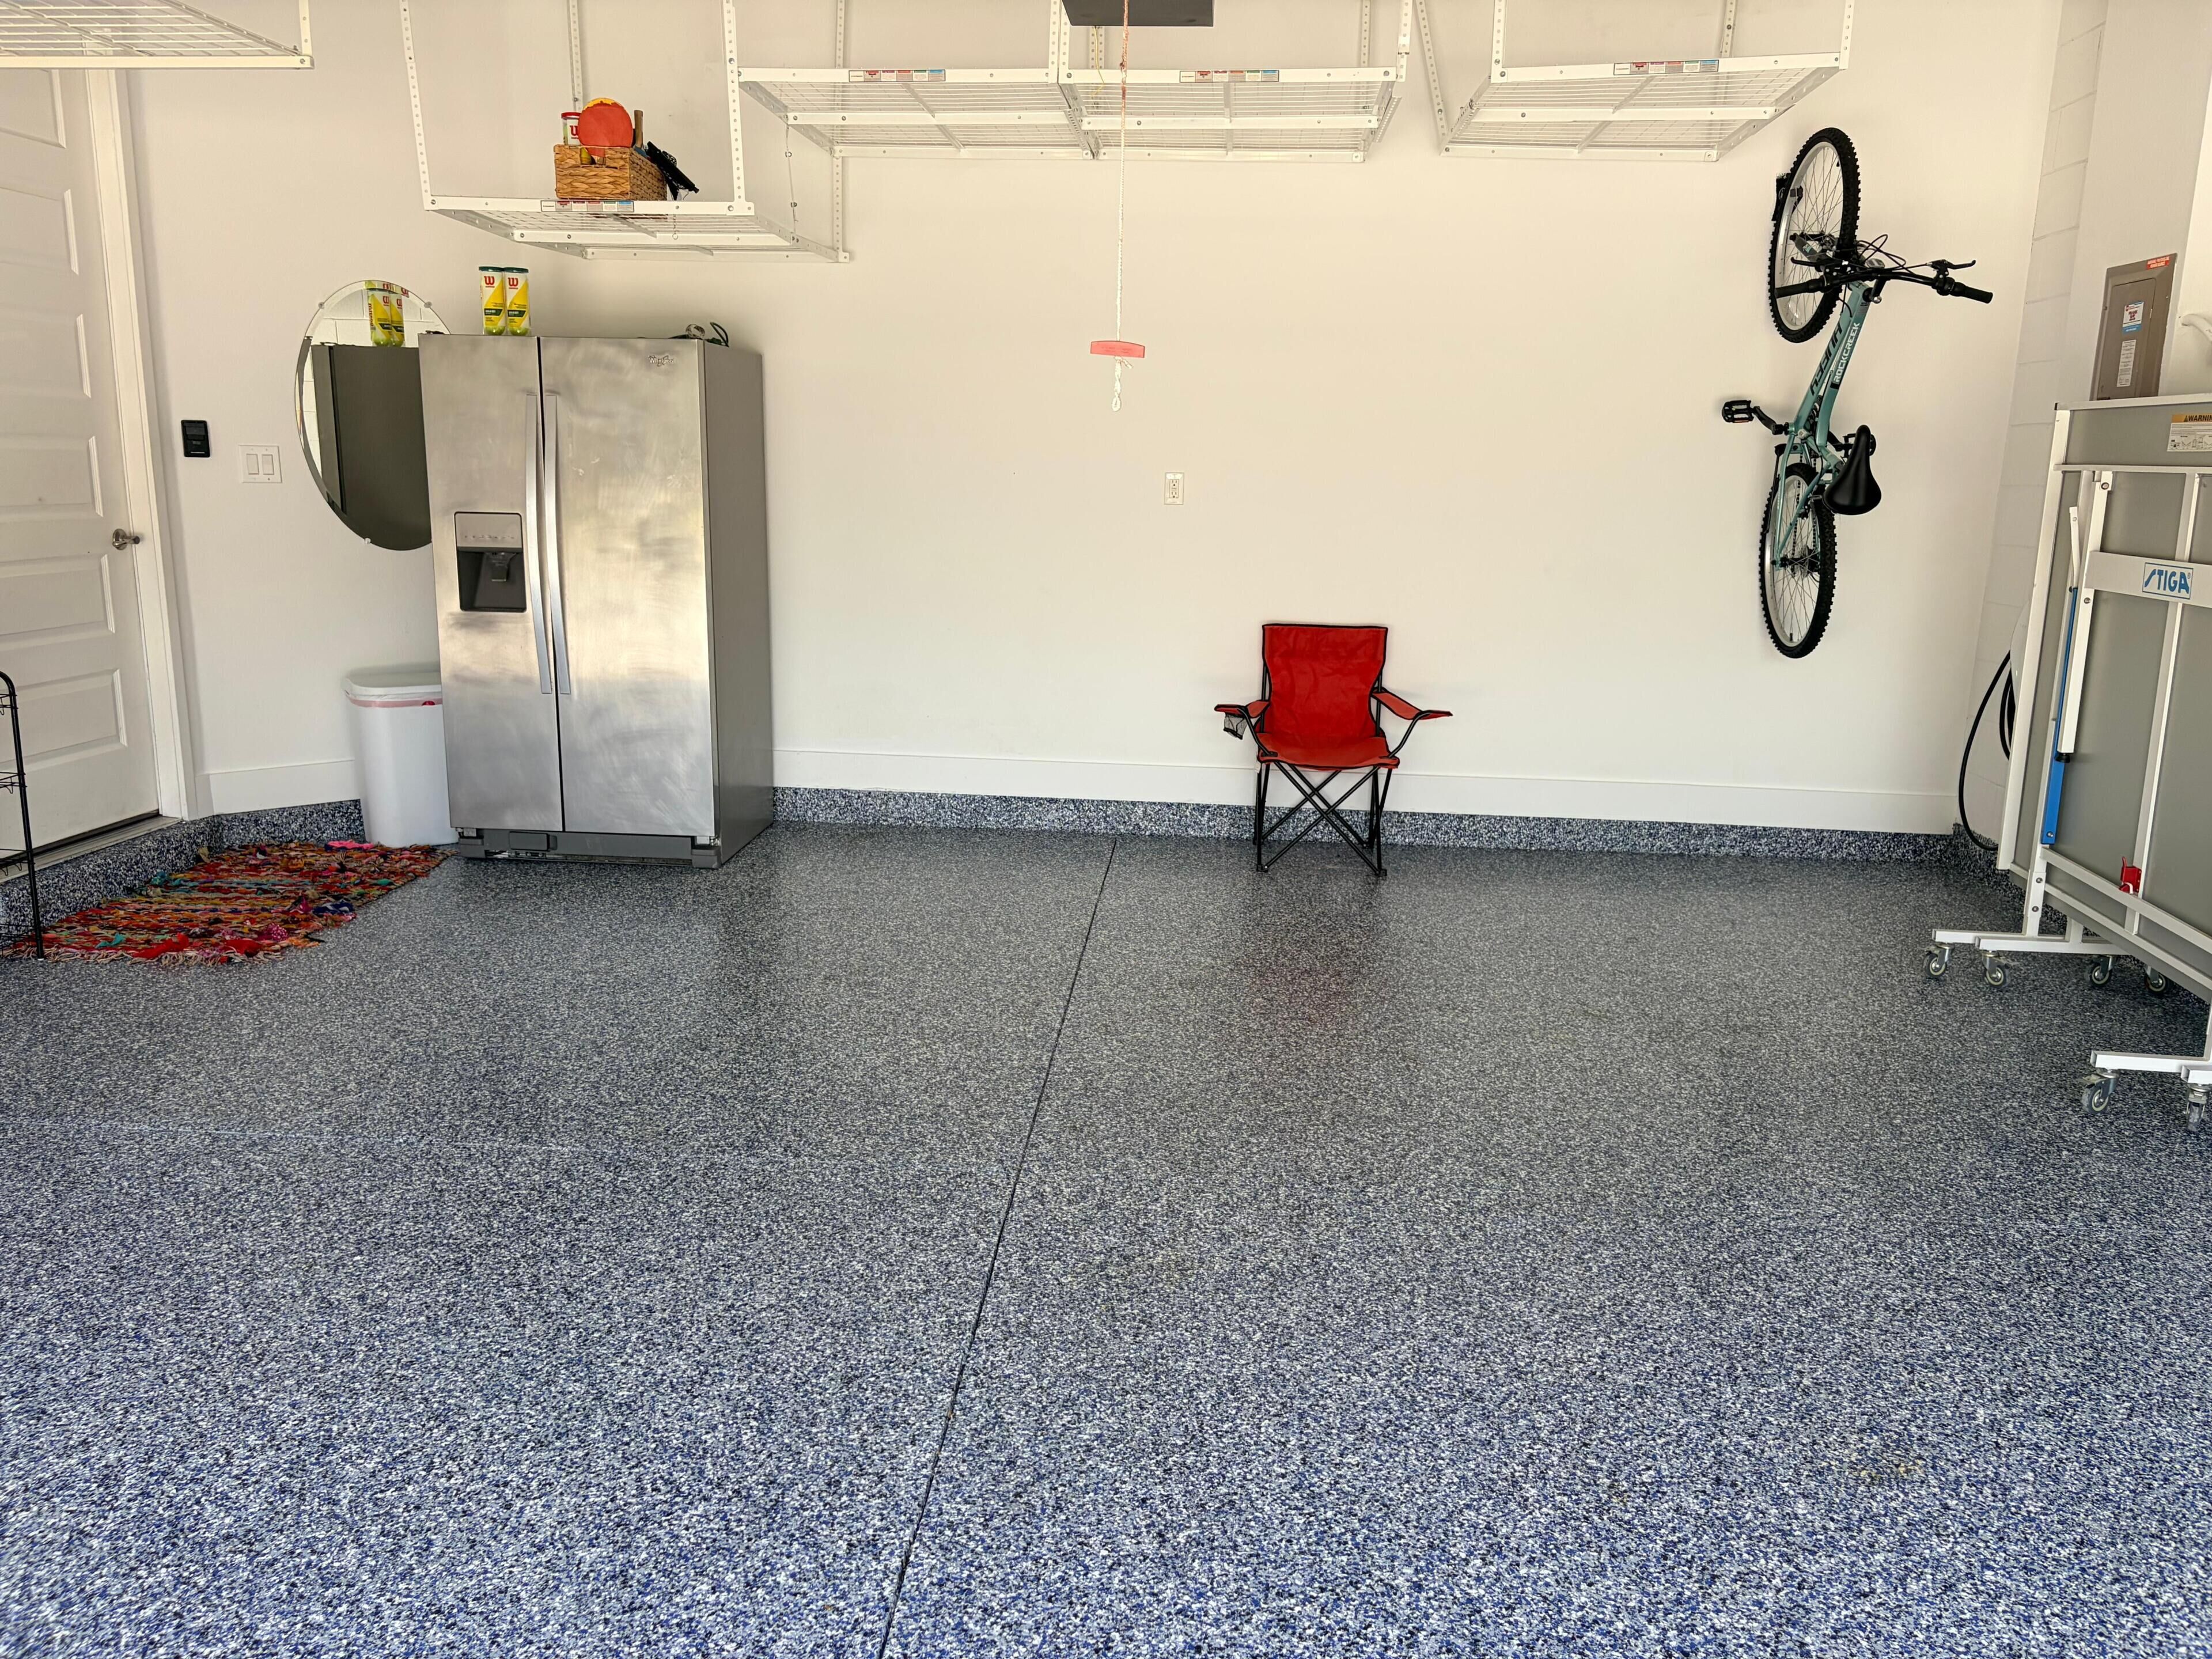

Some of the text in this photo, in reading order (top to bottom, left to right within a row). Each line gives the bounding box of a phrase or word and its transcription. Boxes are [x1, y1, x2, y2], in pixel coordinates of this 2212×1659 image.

[484, 276, 495, 285] W
[508, 277, 518, 287] W
[1810, 321, 1843, 396] HUFFY
[1833, 322, 1861, 382] ROCKCREEK
[2144, 569, 2190, 594] STIGA
